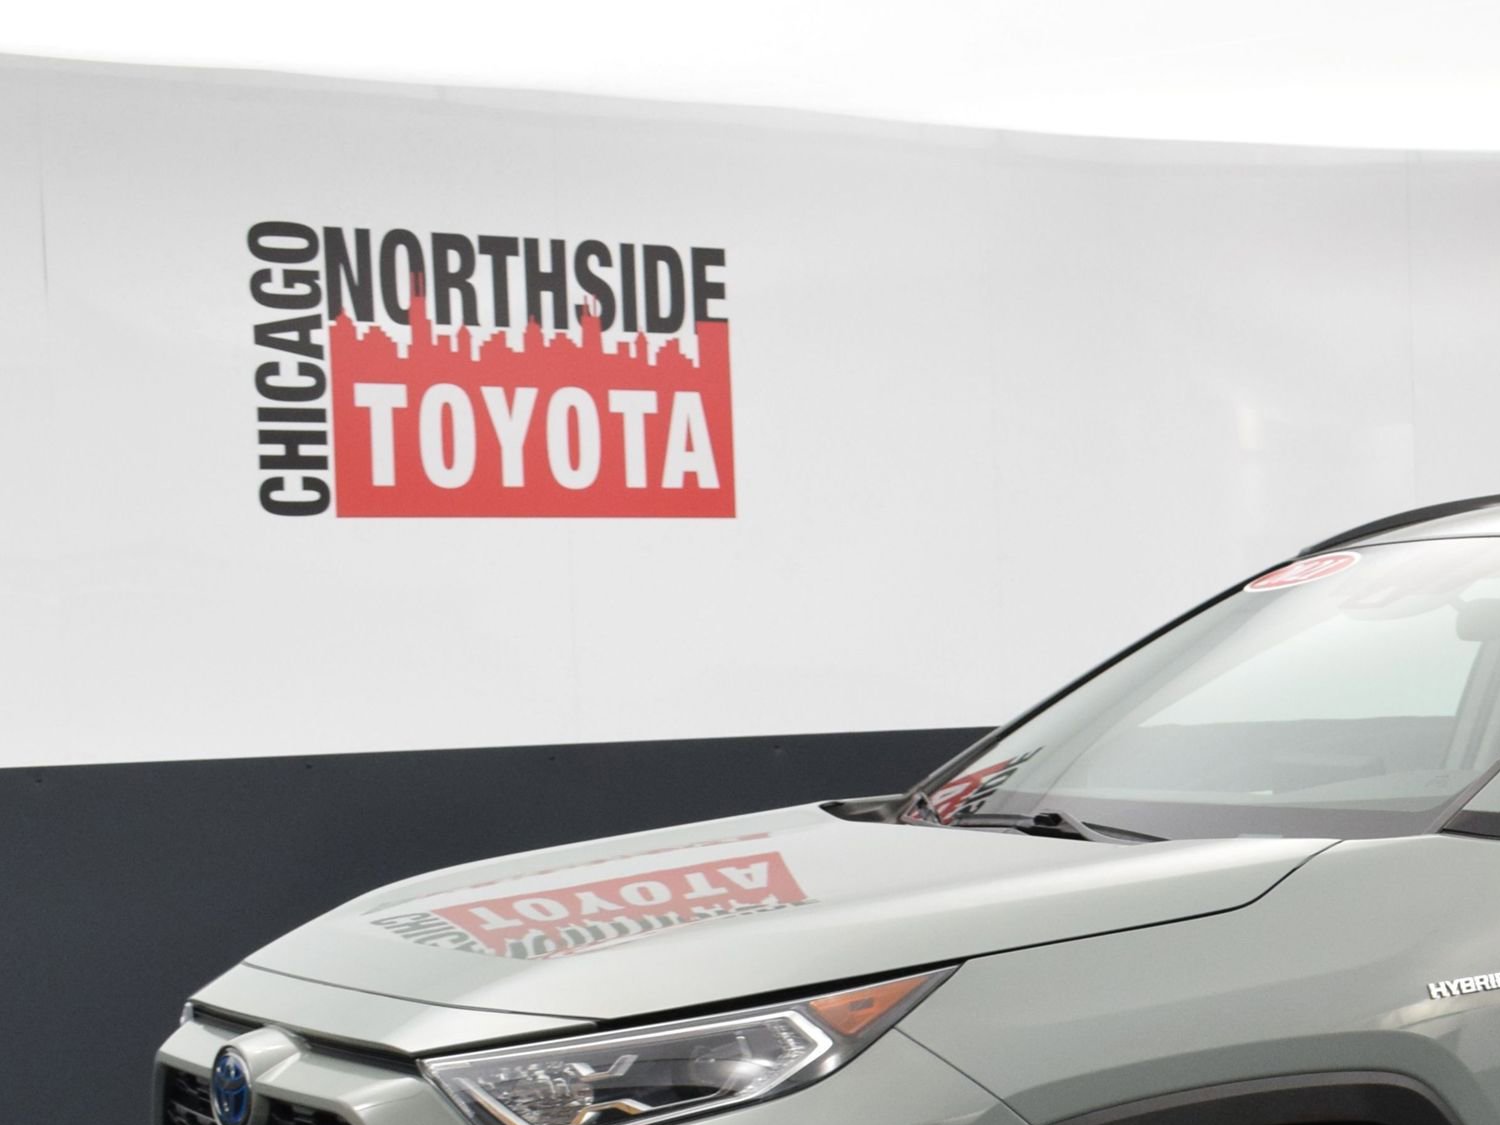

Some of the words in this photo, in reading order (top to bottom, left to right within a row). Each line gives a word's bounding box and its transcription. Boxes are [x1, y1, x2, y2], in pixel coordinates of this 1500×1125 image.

[322, 225, 729, 335] NORTHSIDE
[247, 221, 331, 517] CHICAGO
[354, 382, 721, 490] TOYOTA
